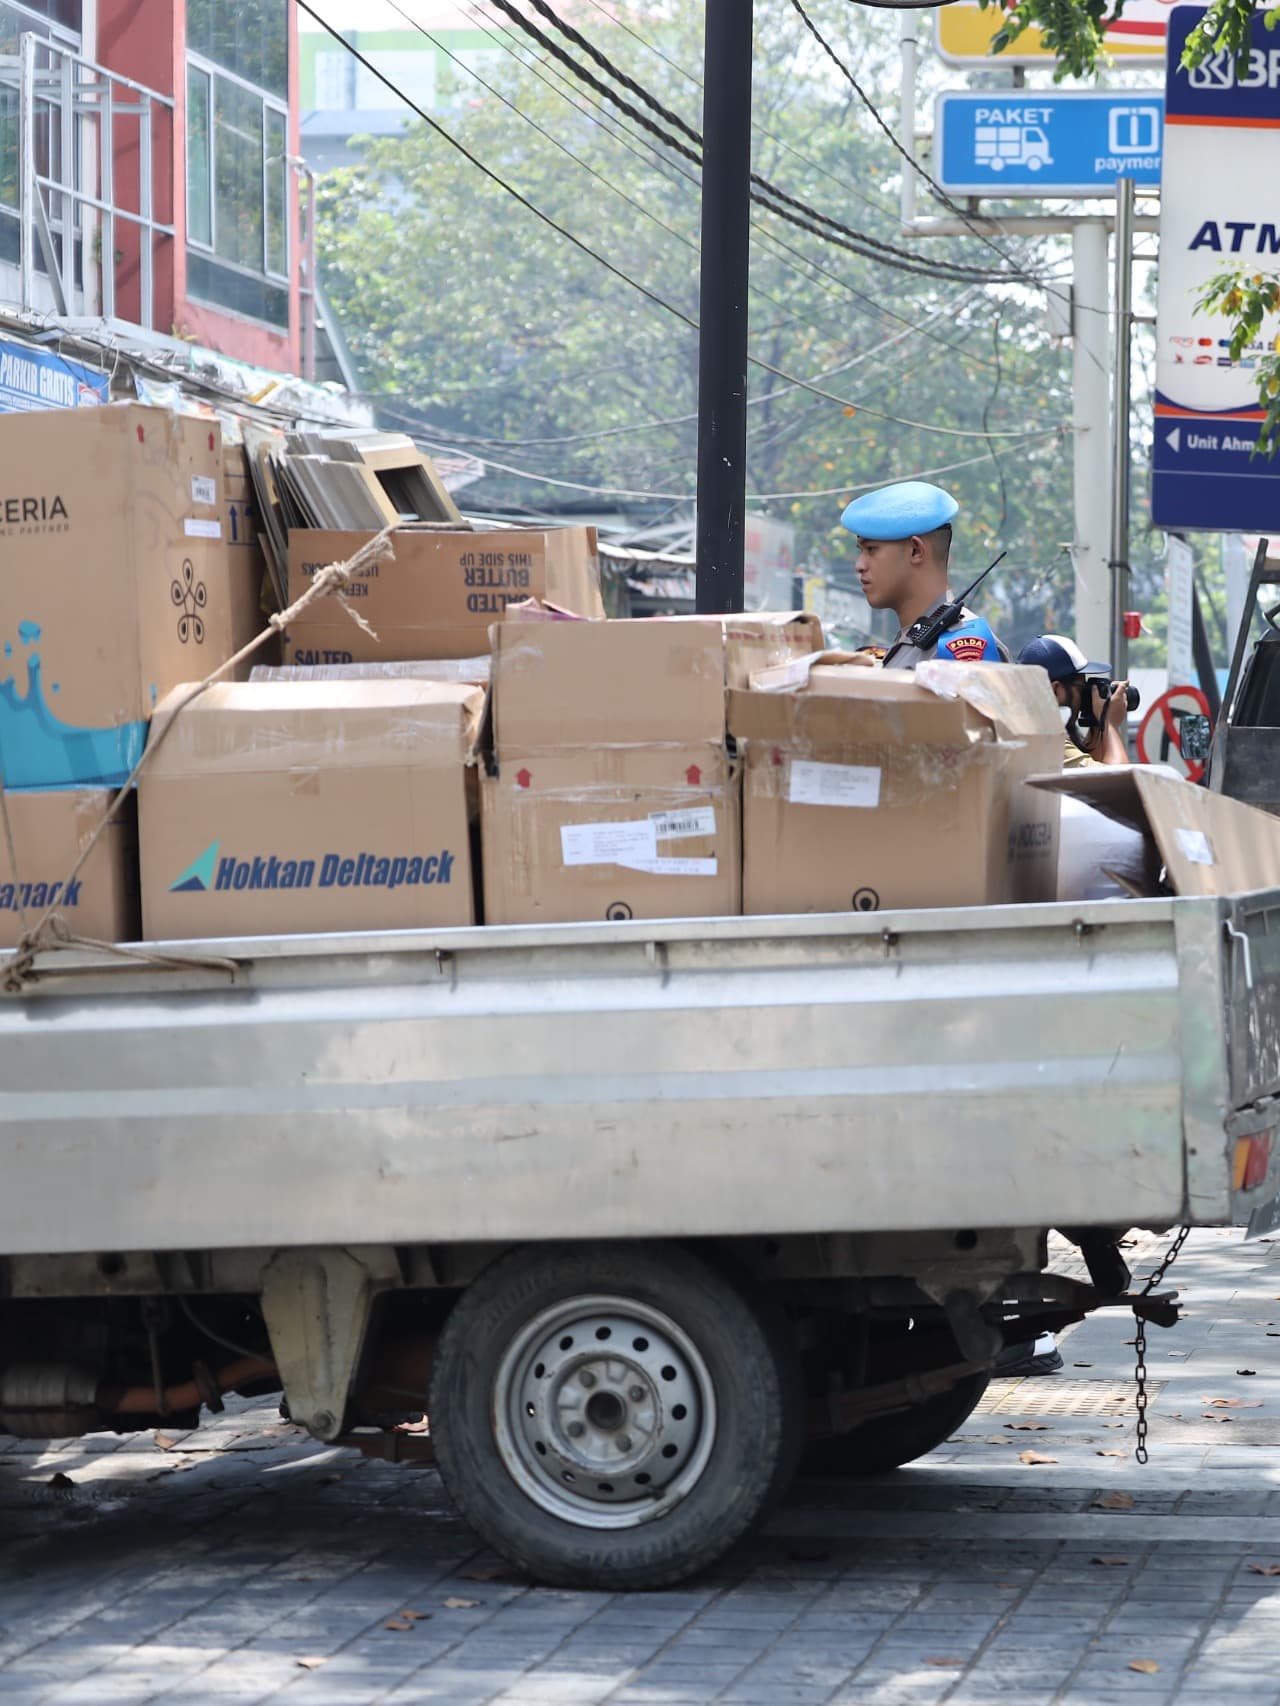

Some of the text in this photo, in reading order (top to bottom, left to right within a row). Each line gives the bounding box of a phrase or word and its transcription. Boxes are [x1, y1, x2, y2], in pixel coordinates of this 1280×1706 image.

[975, 108, 1054, 124] PAKET
[0, 352, 38, 396] PARKIR
[40, 365, 75, 407] GRATIS
[1187, 434, 1219, 450] Unit
[0, 496, 68, 522] ERIA
[460, 553, 475, 566] UP
[479, 553, 504, 566] SIDE
[464, 568, 530, 587] BUTTER
[950, 638, 982, 649] POLDA
[214, 850, 455, 890] Hokkan Deltapack
